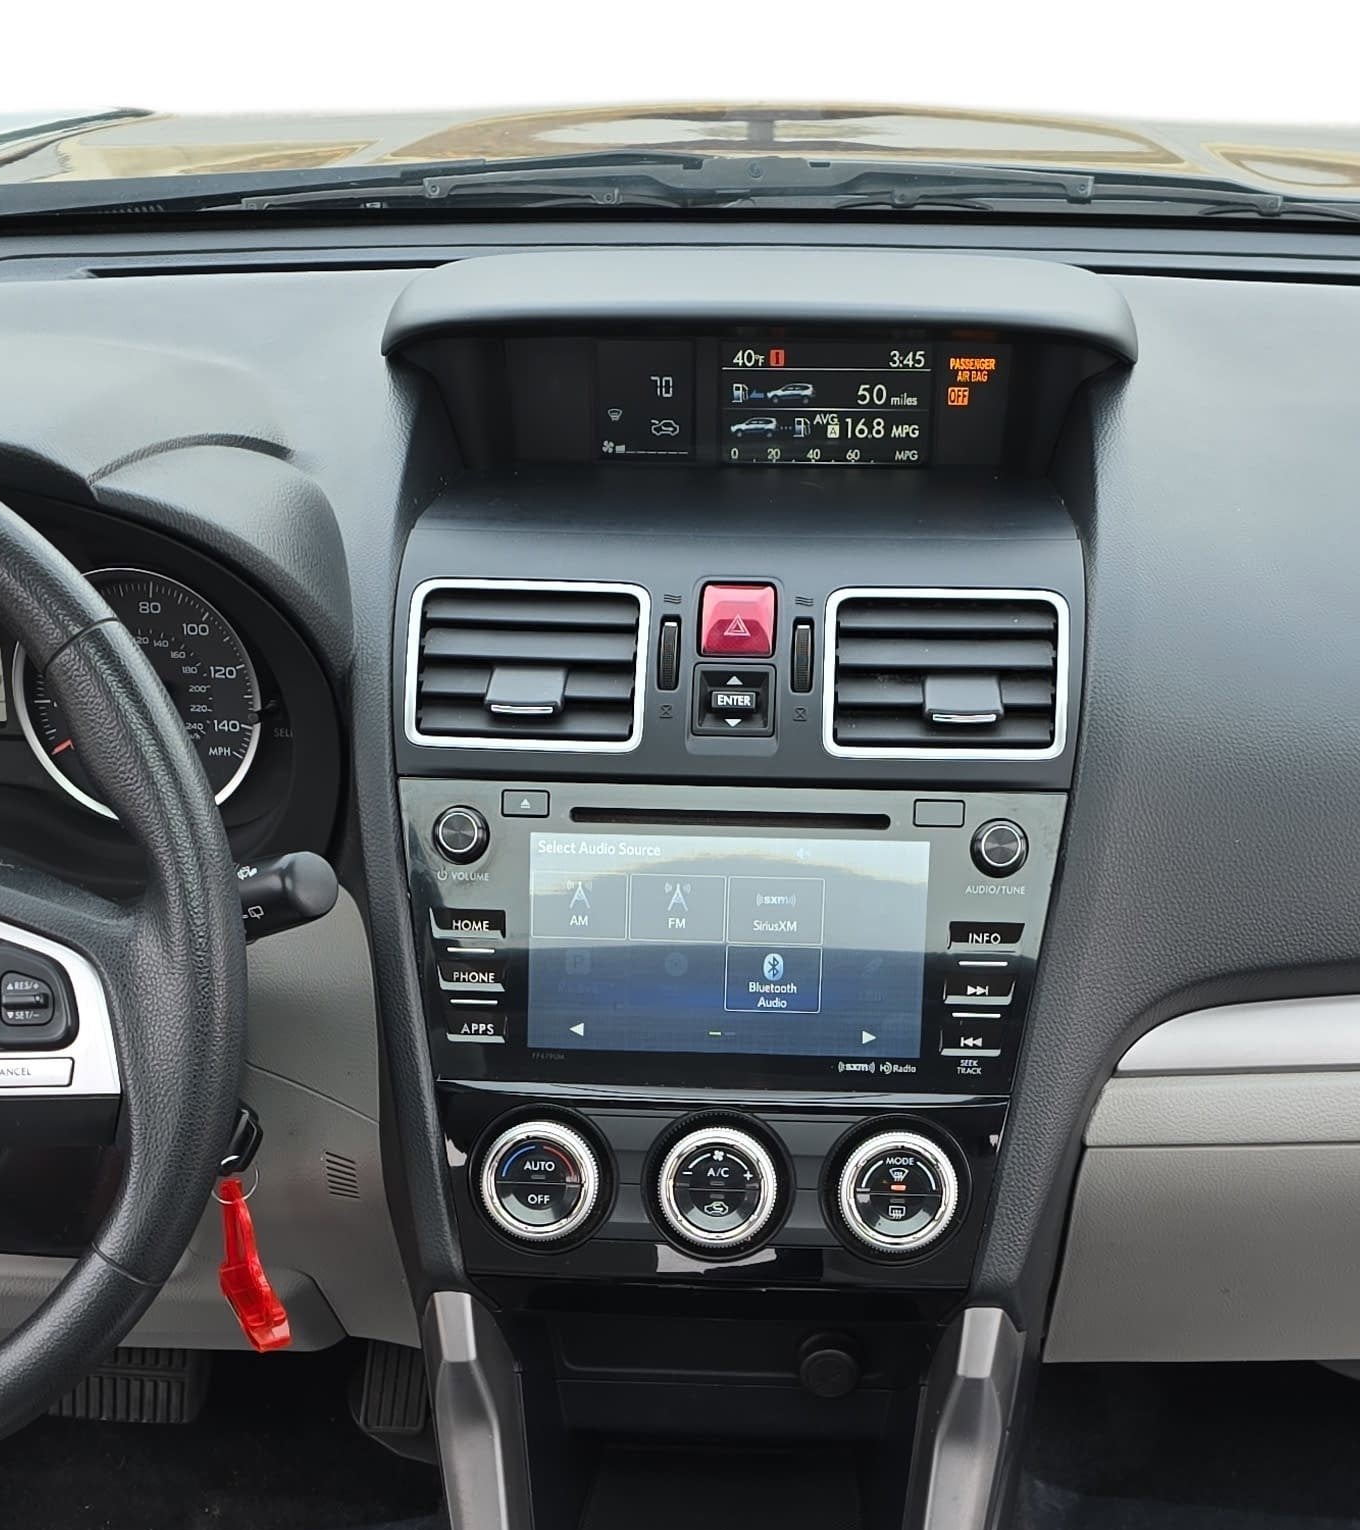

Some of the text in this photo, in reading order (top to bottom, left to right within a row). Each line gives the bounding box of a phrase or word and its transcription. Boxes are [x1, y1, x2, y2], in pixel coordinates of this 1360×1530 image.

[889, 351, 925, 368] 3:45
[949, 358, 996, 371] PASSENGER
[957, 372, 988, 382] AIR BAG
[650, 376, 673, 397] 70
[857, 384, 918, 405] 50 miles
[949, 388, 968, 404] OFF
[845, 418, 919, 439] 16.8 MPG
[731, 448, 739, 460] 0
[767, 449, 781, 460] 20
[806, 449, 821, 460] 40
[846, 449, 860, 460] 60
[895, 450, 918, 461] MPG
[139, 602, 161, 614] 80
[182, 623, 209, 635] 100
[136, 637, 149, 645] 20
[210, 666, 236, 679] 120
[717, 695, 751, 706] ENTER
[213, 720, 240, 732] 140
[208, 747, 231, 756] MPH
[538, 840, 661, 856] Select Audio Source
[451, 872, 489, 881] VOLUME
[965, 885, 1025, 895] AUDIO/TUNE
[452, 920, 490, 932] HOME
[570, 915, 588, 926] AM
[668, 918, 686, 929] FM
[753, 920, 797, 932] SiriusXM
[969, 933, 1001, 944] INFO
[453, 972, 495, 983] PHONE
[748, 981, 797, 995] Bluetooth
[757, 996, 787, 1009] Audio
[460, 1023, 494, 1034] APPS
[893, 1065, 917, 1073] Radio
[957, 1067, 982, 1075] TRACK
[524, 1161, 555, 1172] AUTO
[886, 1157, 915, 1166] MODE
[707, 1168, 730, 1177] A/C
[527, 1194, 550, 1205] OFF
